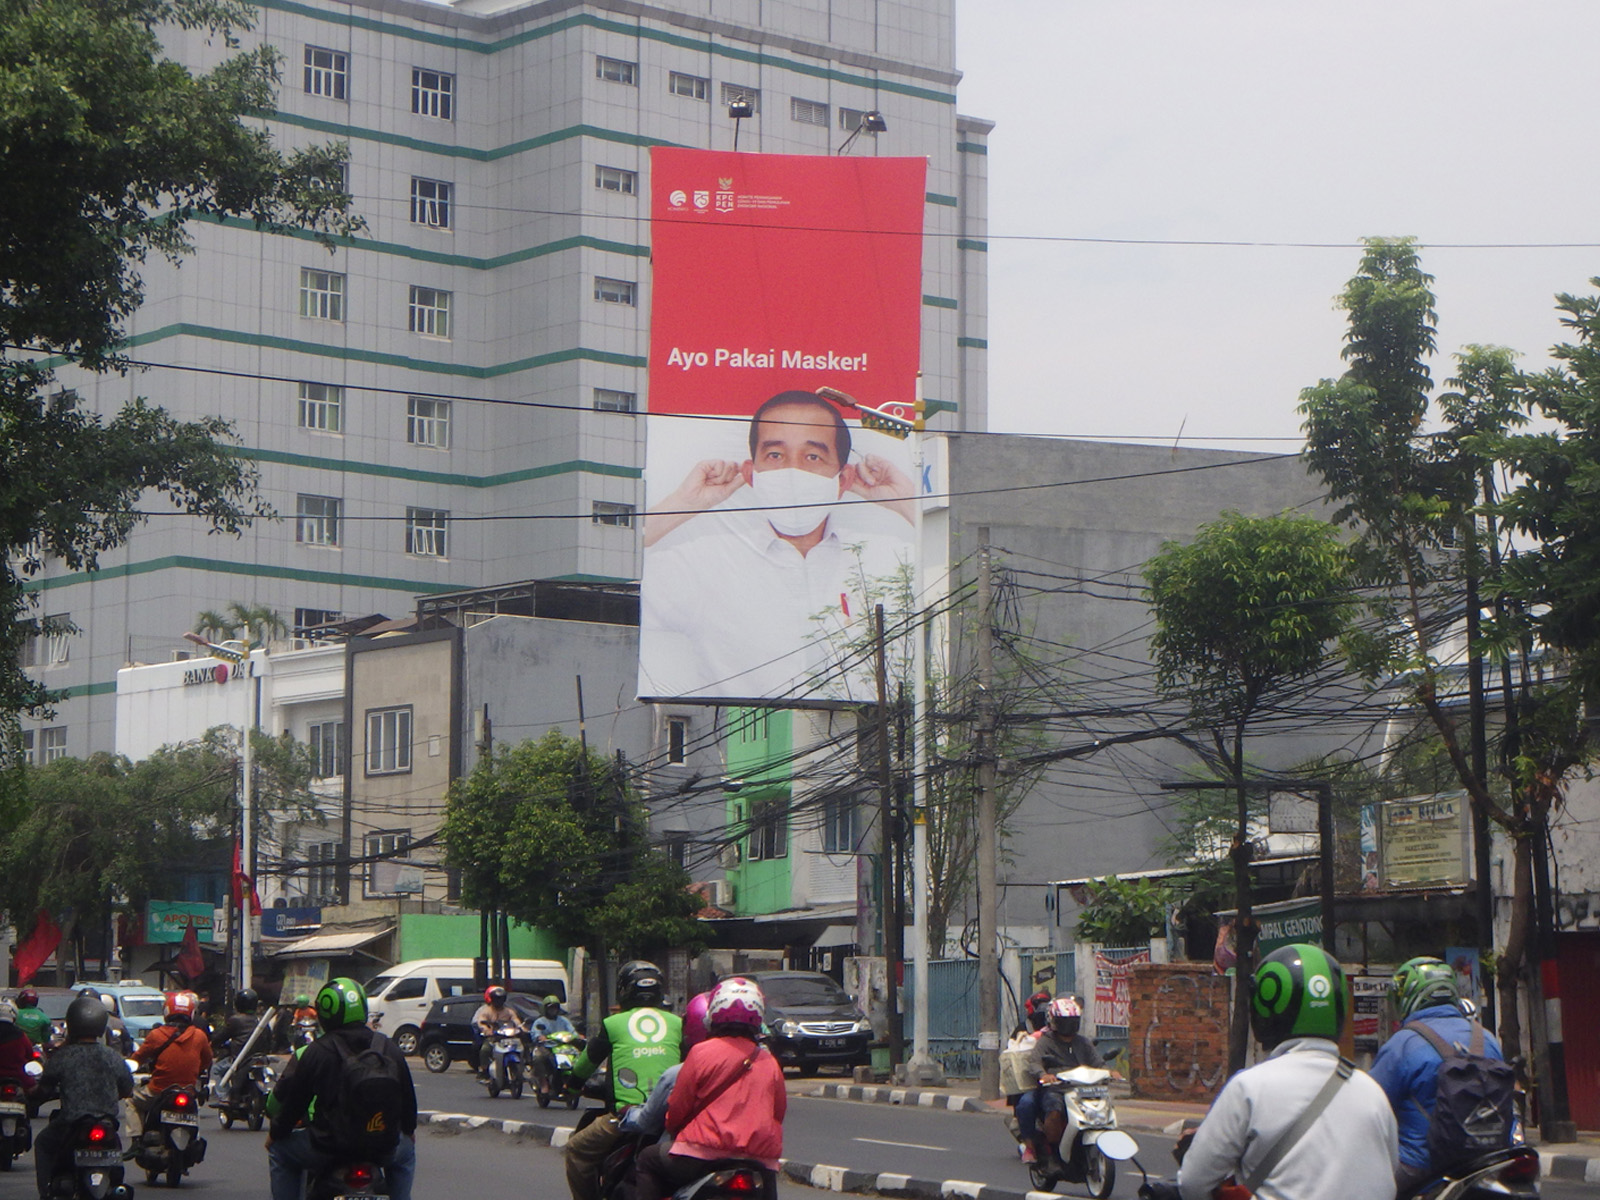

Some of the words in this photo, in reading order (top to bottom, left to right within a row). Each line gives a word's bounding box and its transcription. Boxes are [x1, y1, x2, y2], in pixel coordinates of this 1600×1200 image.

[667, 347, 708, 371] Ayo
[714, 347, 775, 369] Pakai
[781, 349, 868, 371] Masker!
[184, 667, 216, 685] BANK
[632, 1046, 667, 1058] gojek
